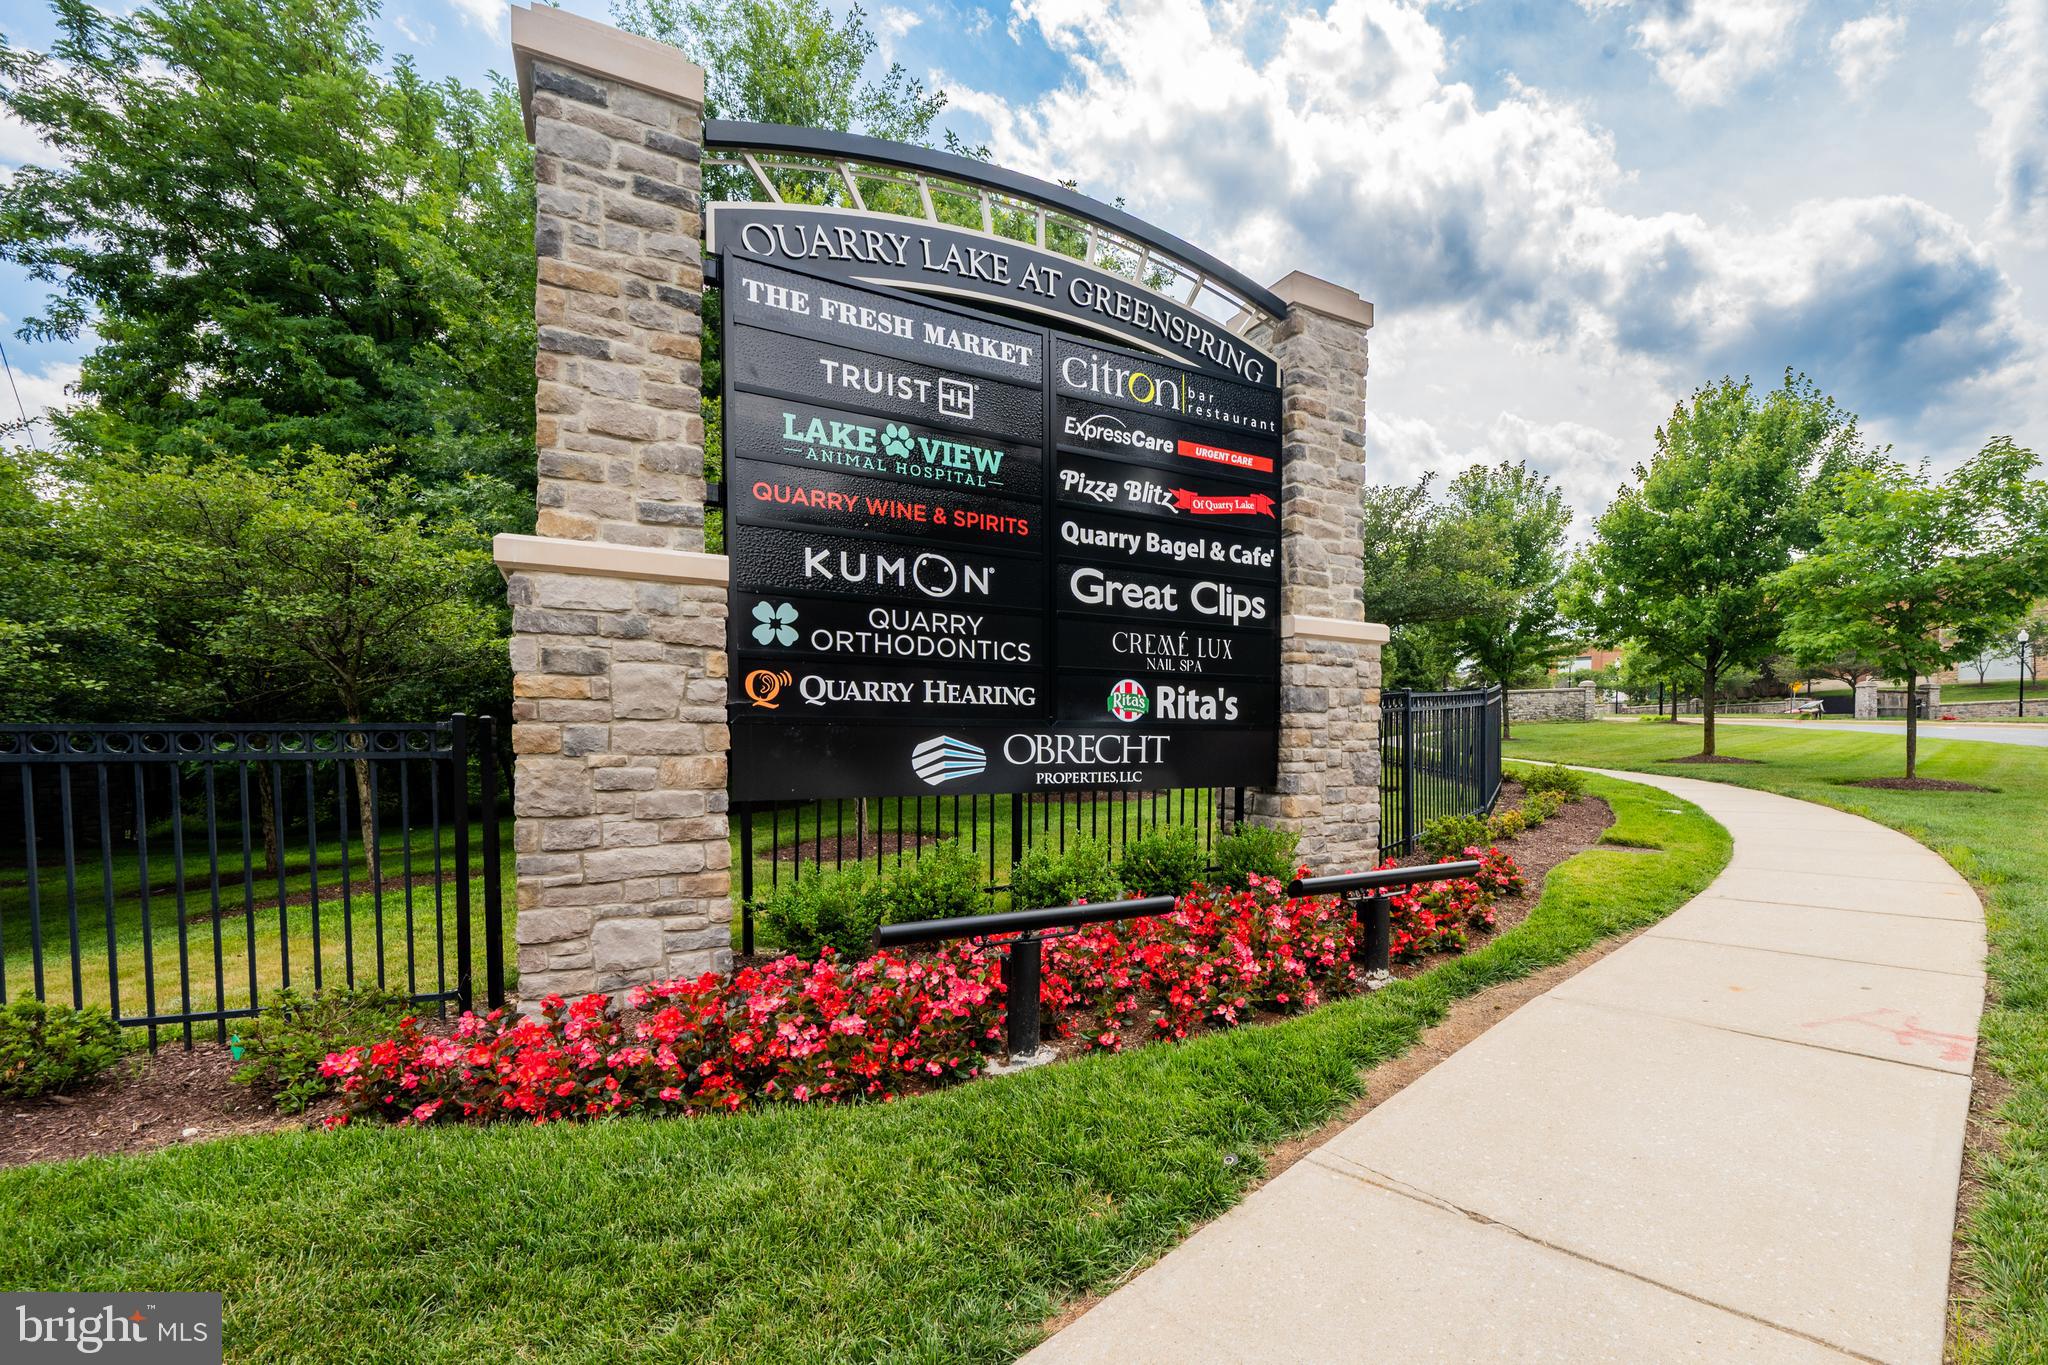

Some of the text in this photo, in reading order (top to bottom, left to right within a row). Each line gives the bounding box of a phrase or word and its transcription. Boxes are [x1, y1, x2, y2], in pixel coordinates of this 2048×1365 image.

[741, 223, 1265, 383] QUARRY LAKE AT GREENSPRING
[742, 278, 1032, 366] THE FRESH MARKET
[819, 358, 932, 403] TRUIST
[1188, 386, 1215, 403] bar
[1064, 416, 1174, 453] ExpressCare
[1188, 403, 1275, 432] restaurant
[783, 412, 1004, 475] LAKE VIEW
[1195, 447, 1253, 467] URGENT CARE
[805, 448, 987, 488] ANIMAL HOSPITAL
[752, 482, 1029, 536] QUARRY WINE & SPIRITS
[1059, 469, 1178, 514] Pizza Blitz
[1192, 500, 1255, 511] Of Quarry Lake
[1061, 521, 1141, 554] Quarry
[1146, 532, 1205, 561] Bagel
[1210, 542, 1226, 561] &
[804, 547, 989, 597] KUMON
[1070, 567, 1266, 626] Great Clips
[868, 608, 984, 636] QUARRY
[810, 629, 1032, 662] ORTHODONTICS
[1112, 631, 1233, 660] CREMÉ LUX
[1146, 657, 1202, 673] NAIL SPA
[799, 675, 914, 706] QUARRY
[923, 679, 1036, 706] HEARING
[1156, 685, 1238, 721] Rita's
[1003, 734, 1171, 765] OBRECHT
